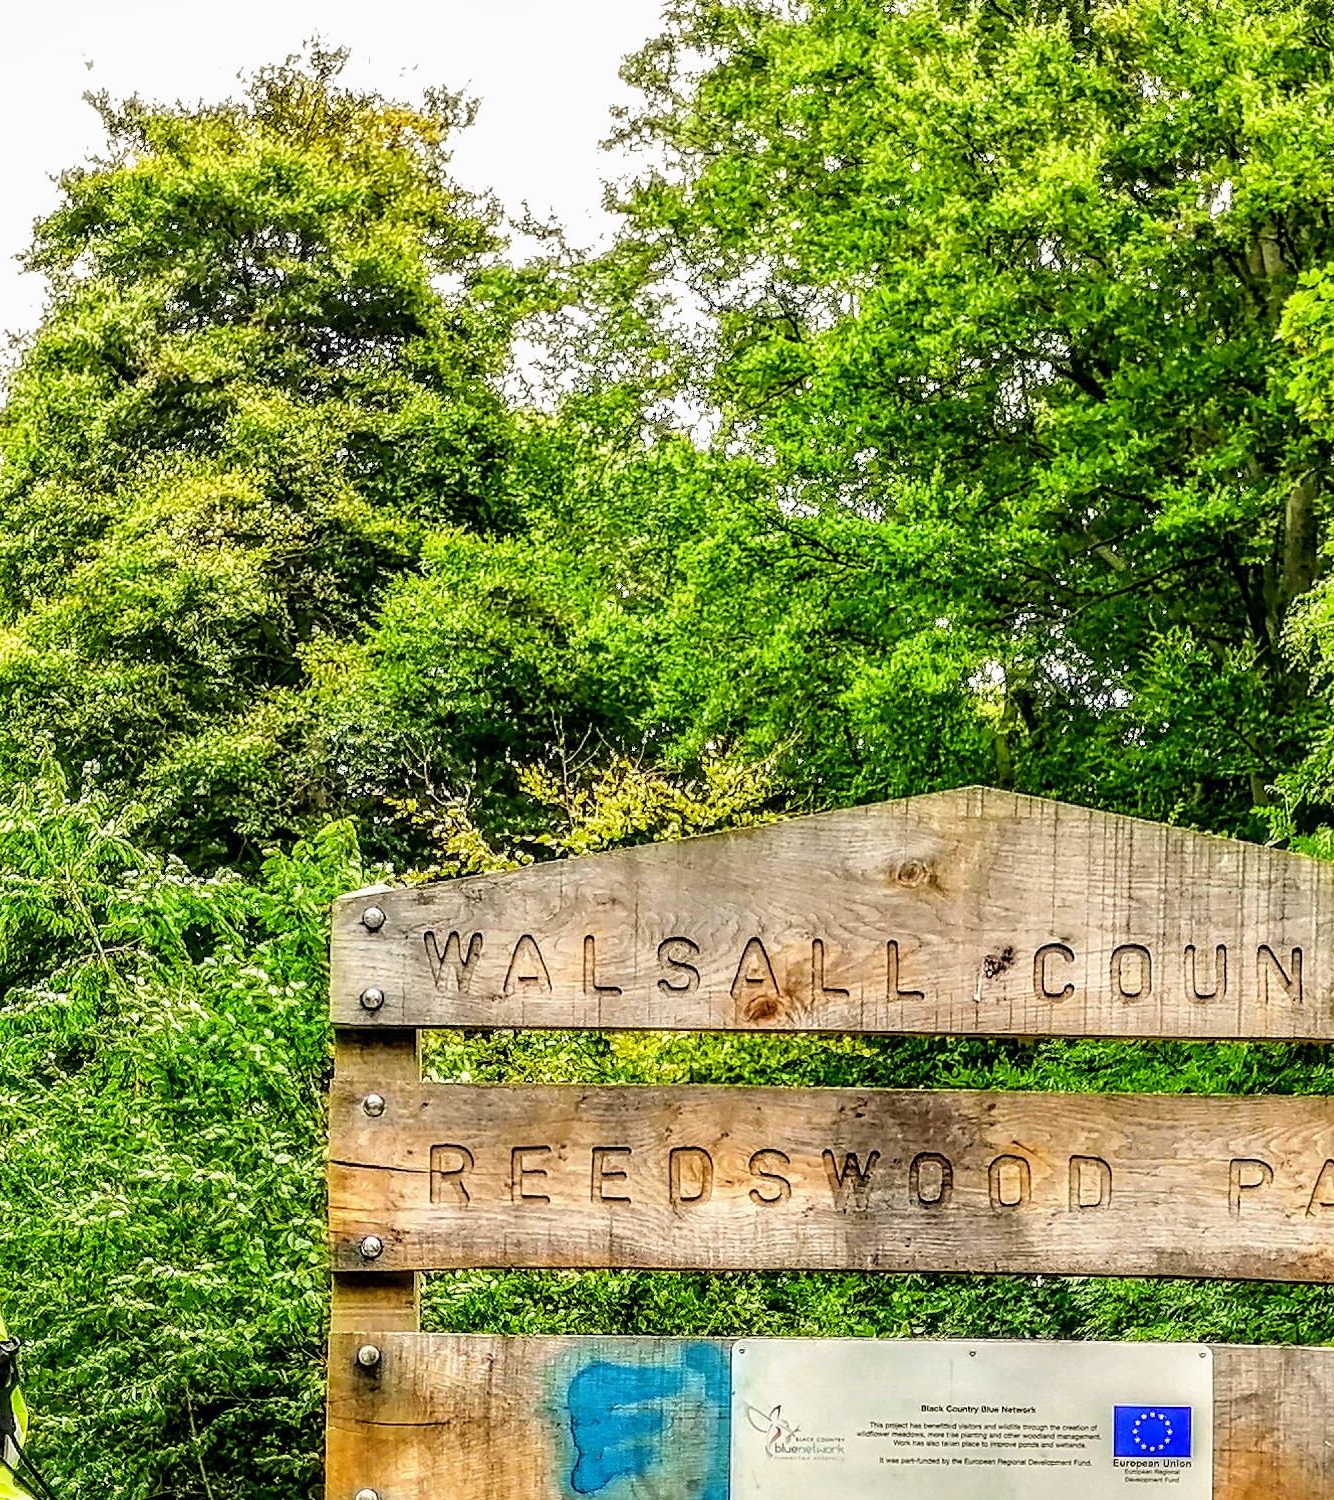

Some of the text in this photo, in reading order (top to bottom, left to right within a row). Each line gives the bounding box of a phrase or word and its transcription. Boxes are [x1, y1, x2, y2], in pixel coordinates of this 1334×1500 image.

[423, 930, 925, 1001] WALSALL
[429, 1142, 1113, 1213] REEDSWOOD
[921, 1404, 1037, 1415] Black Country Blue Network
[885, 1422, 908, 1430] project
[1023, 1424, 1049, 1432] through
[774, 1443, 845, 1454] bluenetwork
[961, 1441, 979, 1449] place
[1019, 1442, 1039, 1450] ponds
[901, 1458, 940, 1466] part-funded
[941, 1458, 949, 1466] by
[998, 1459, 1026, 1467] Regional
[1113, 1459, 1191, 1469] European Union
